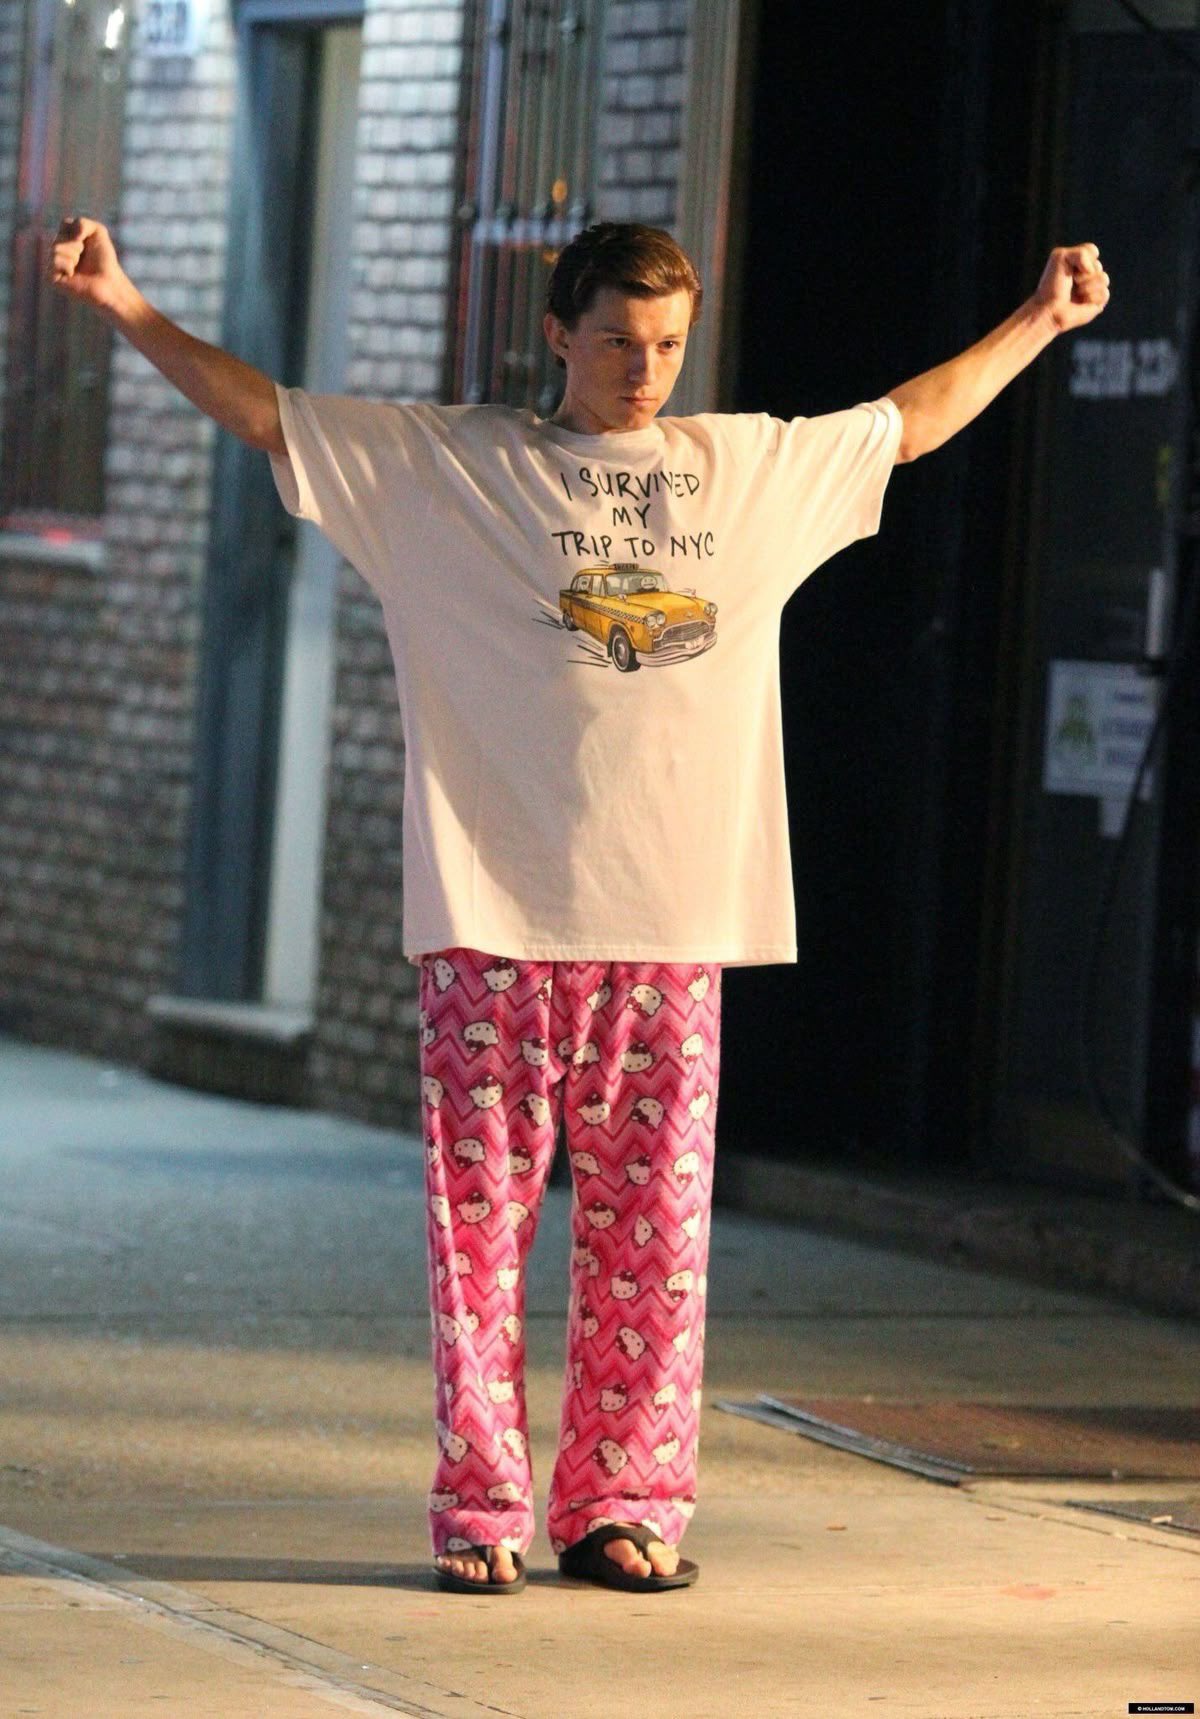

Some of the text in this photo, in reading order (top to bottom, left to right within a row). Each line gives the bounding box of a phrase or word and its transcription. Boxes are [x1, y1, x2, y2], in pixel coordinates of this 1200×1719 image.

[560, 466, 700, 501] I SURVIVED
[612, 503, 651, 529] MY
[551, 530, 714, 560] TRIP TO NYC
